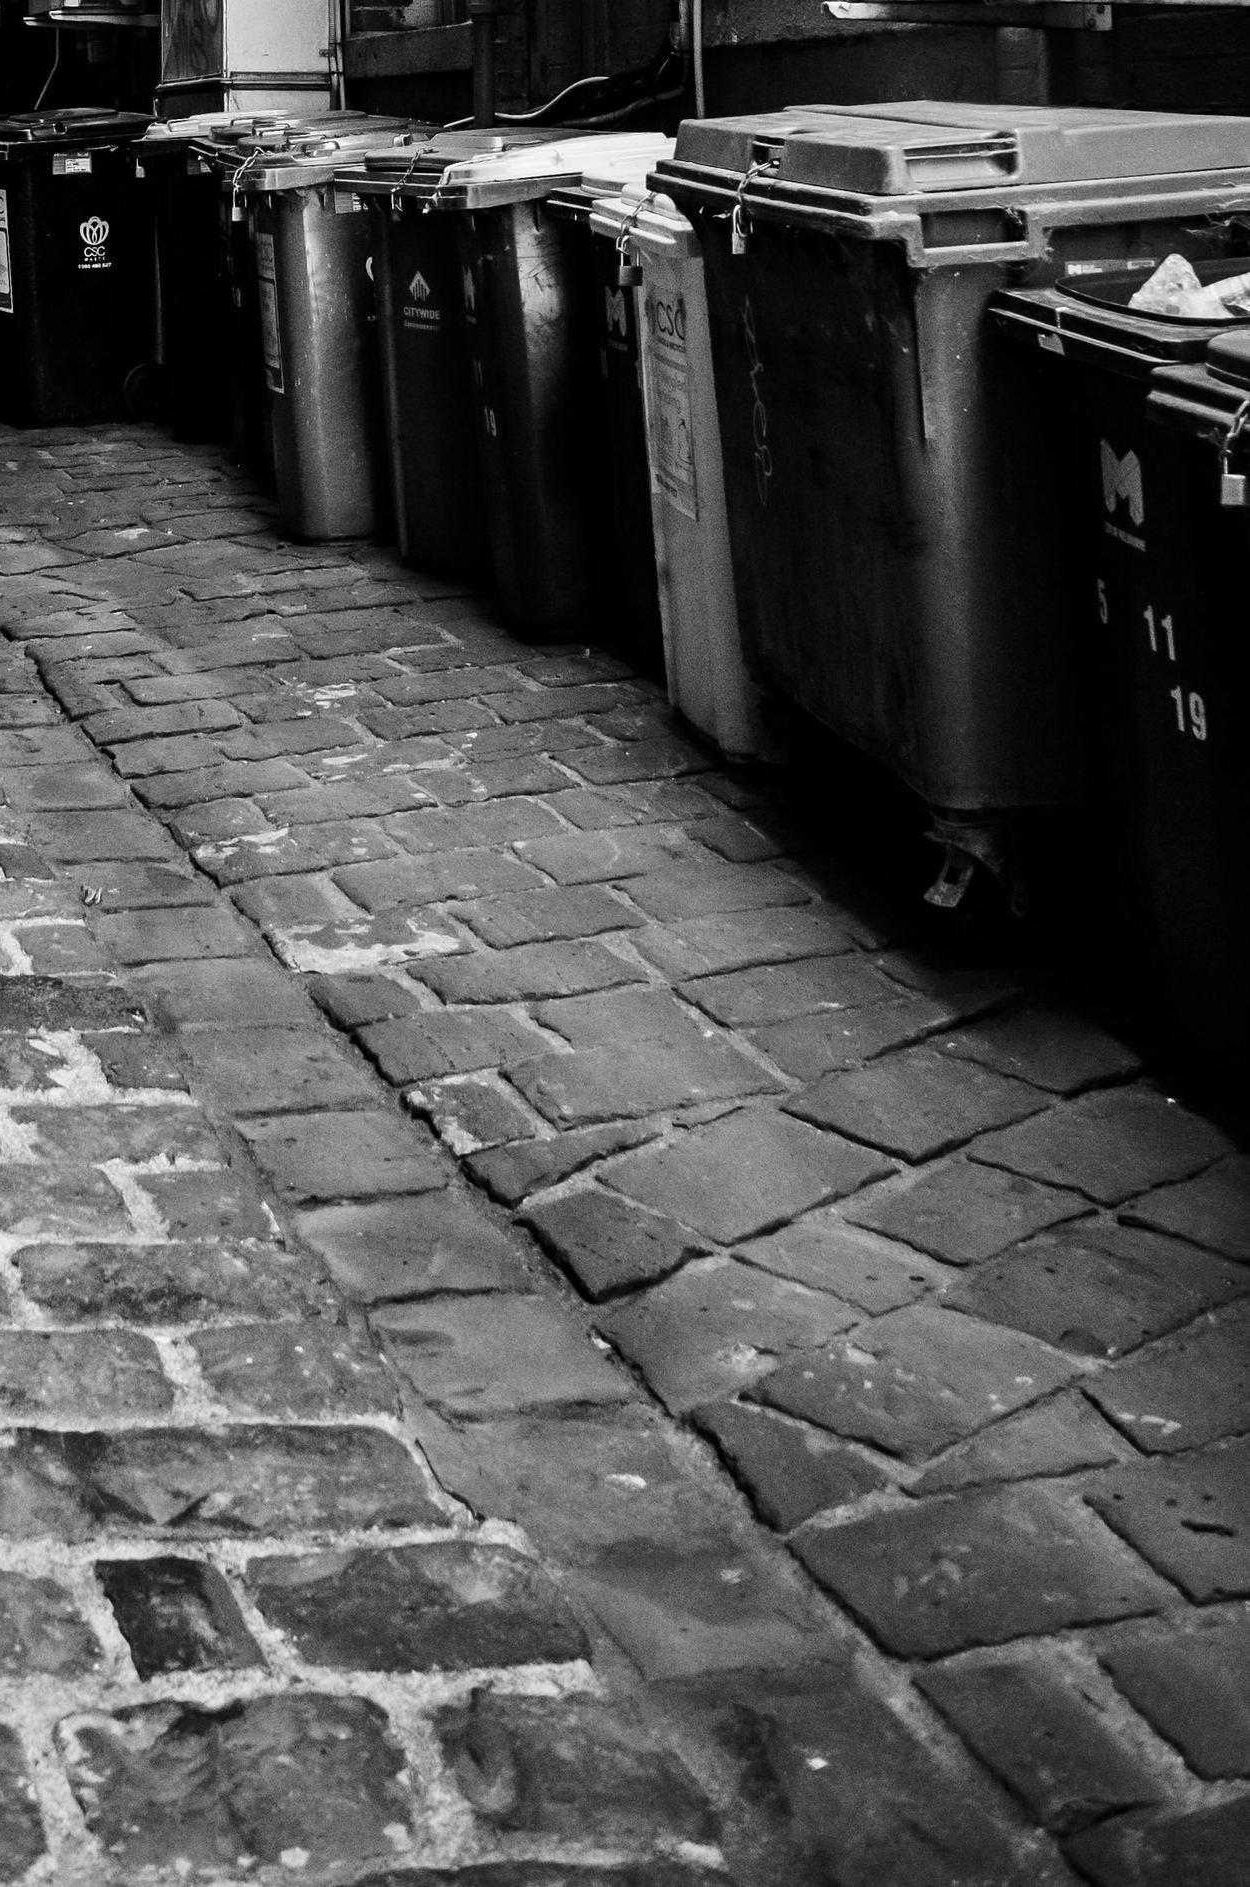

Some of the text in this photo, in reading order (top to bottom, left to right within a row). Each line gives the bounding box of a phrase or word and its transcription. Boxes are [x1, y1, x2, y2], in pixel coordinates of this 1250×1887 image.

[83, 245, 106, 257] CSC
[403, 306, 441, 320] CITYWIDE
[1143, 605, 1176, 661] 11
[1170, 685, 1207, 741] 19
